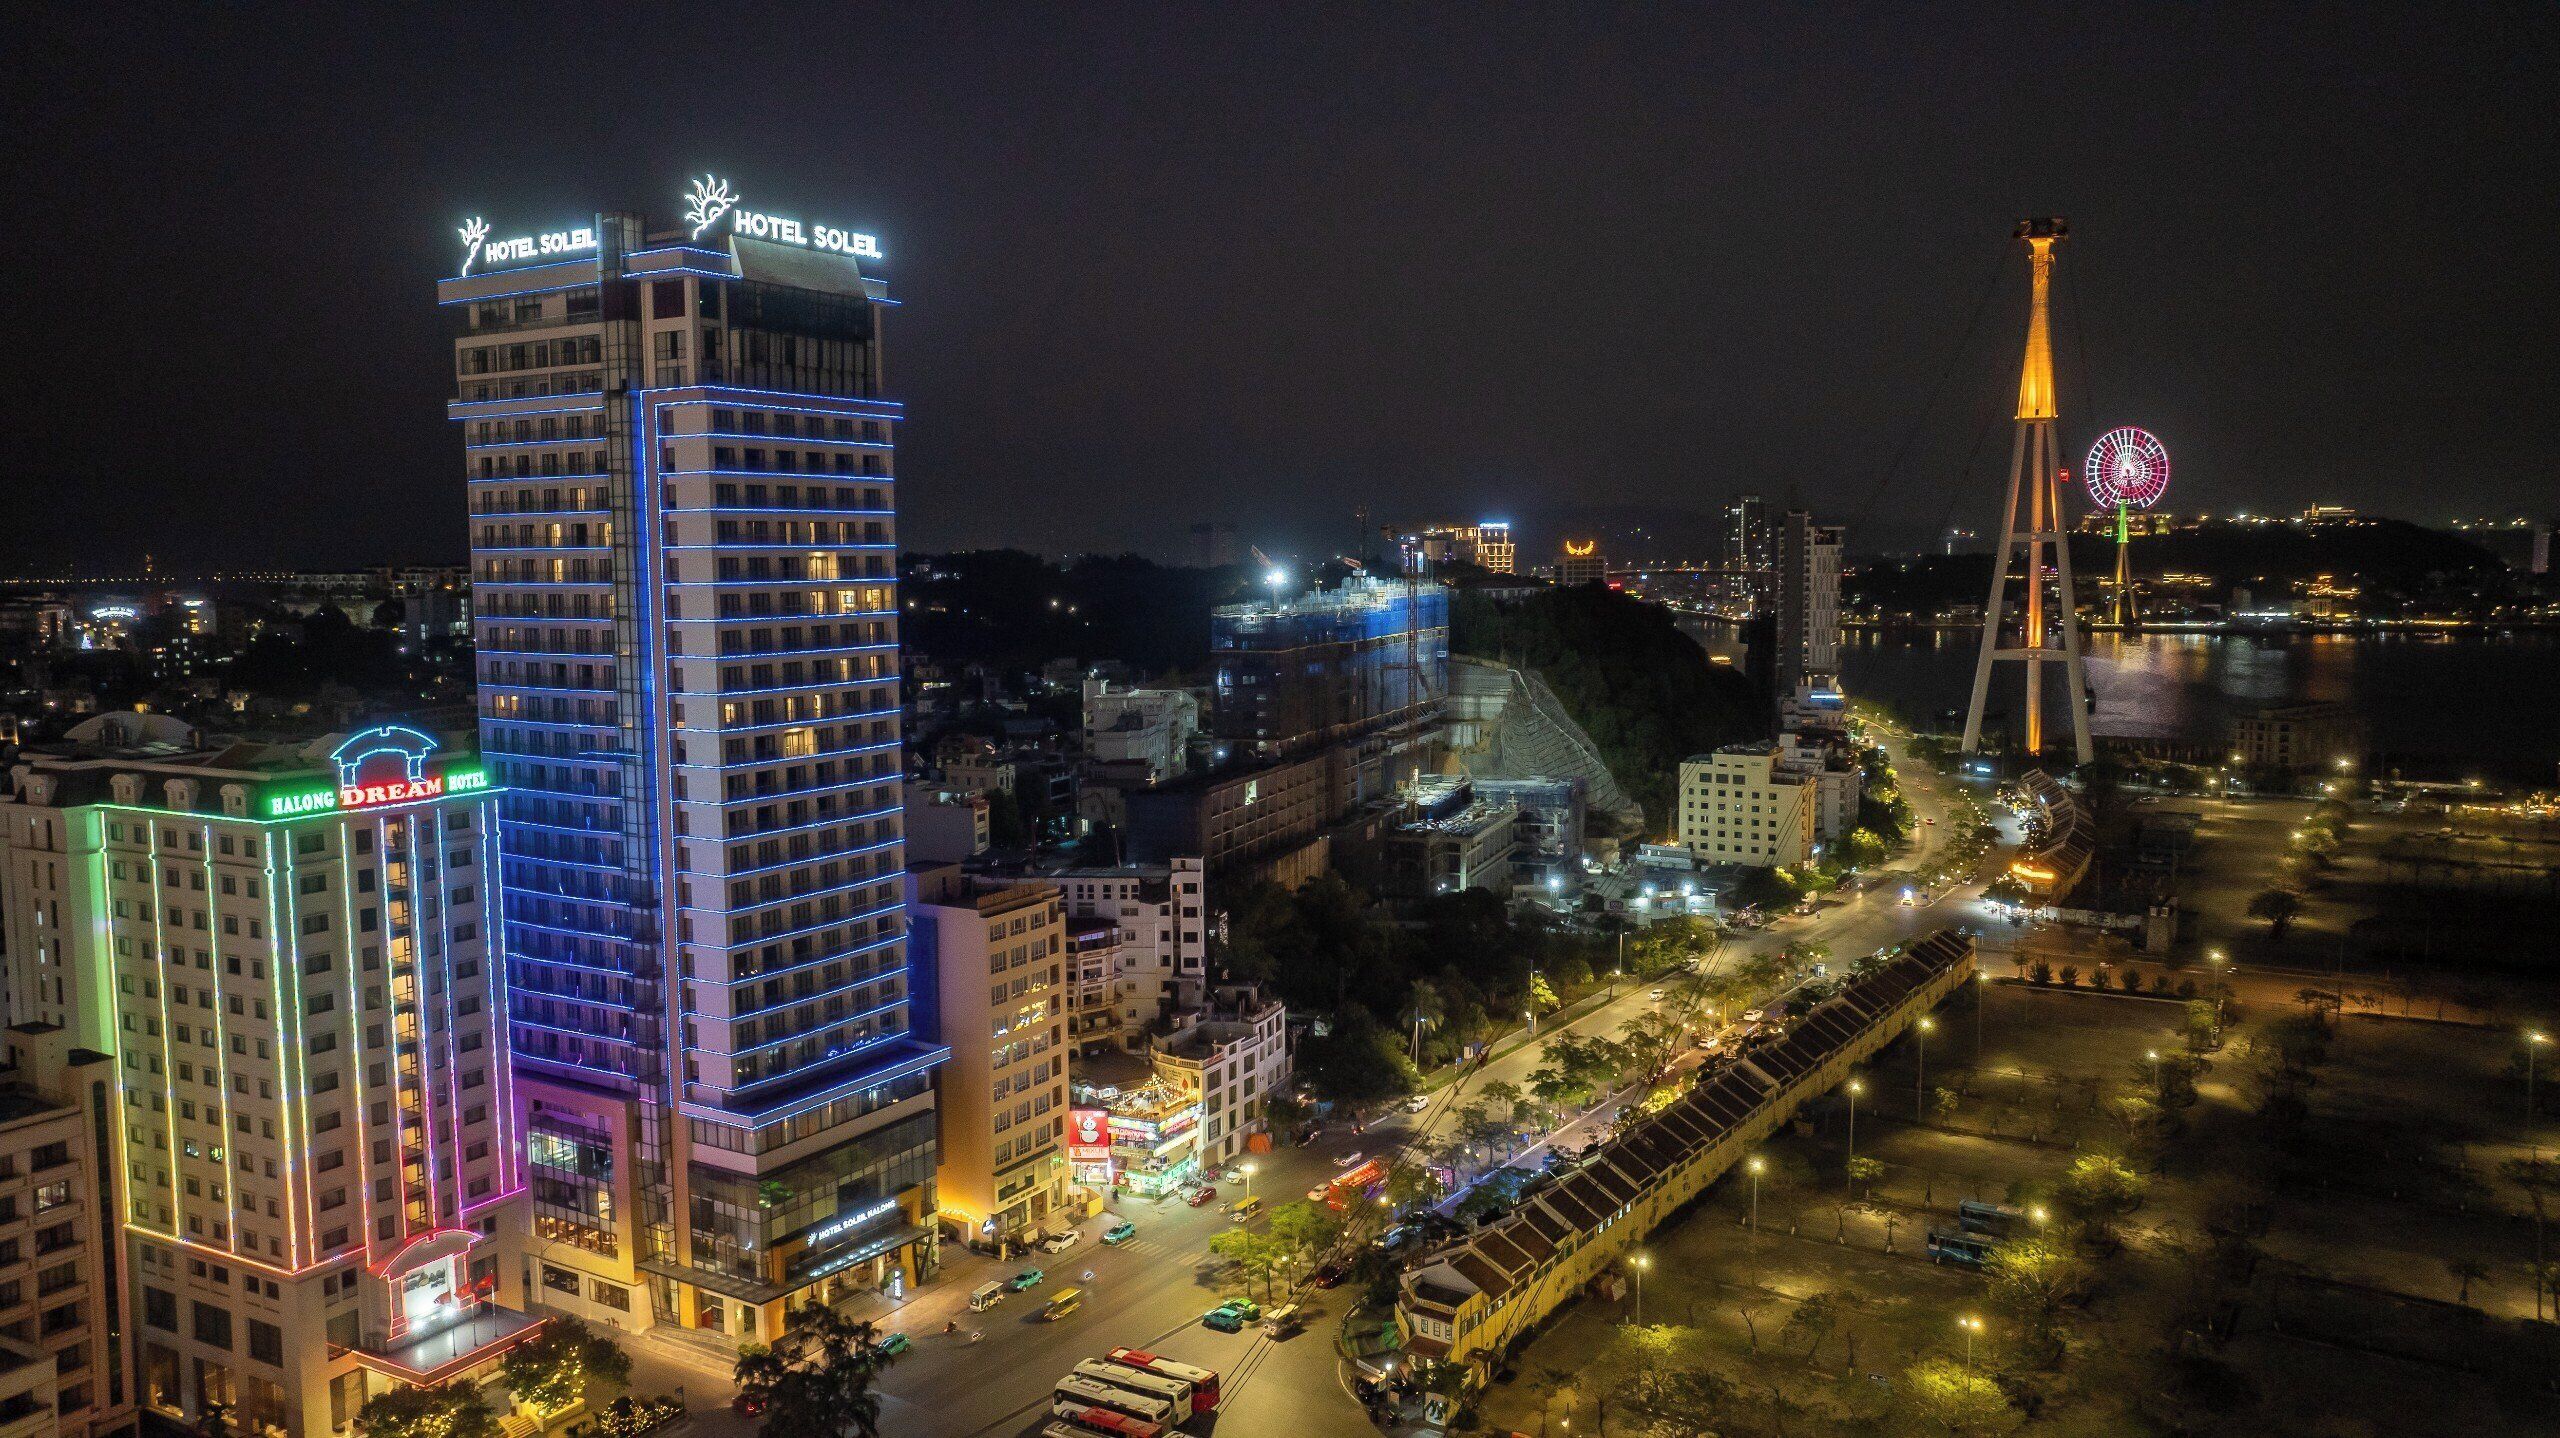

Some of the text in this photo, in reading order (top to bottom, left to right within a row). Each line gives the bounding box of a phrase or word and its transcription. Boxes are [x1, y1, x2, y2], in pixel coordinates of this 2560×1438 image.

[485, 228, 597, 263] HOTEL SOLEIL
[735, 210, 883, 259] HOTEL SOLEIL
[271, 771, 488, 815] HALONG DREAM HOTEL
[819, 1200, 895, 1240] HOTEL SOLEIL HALONG
